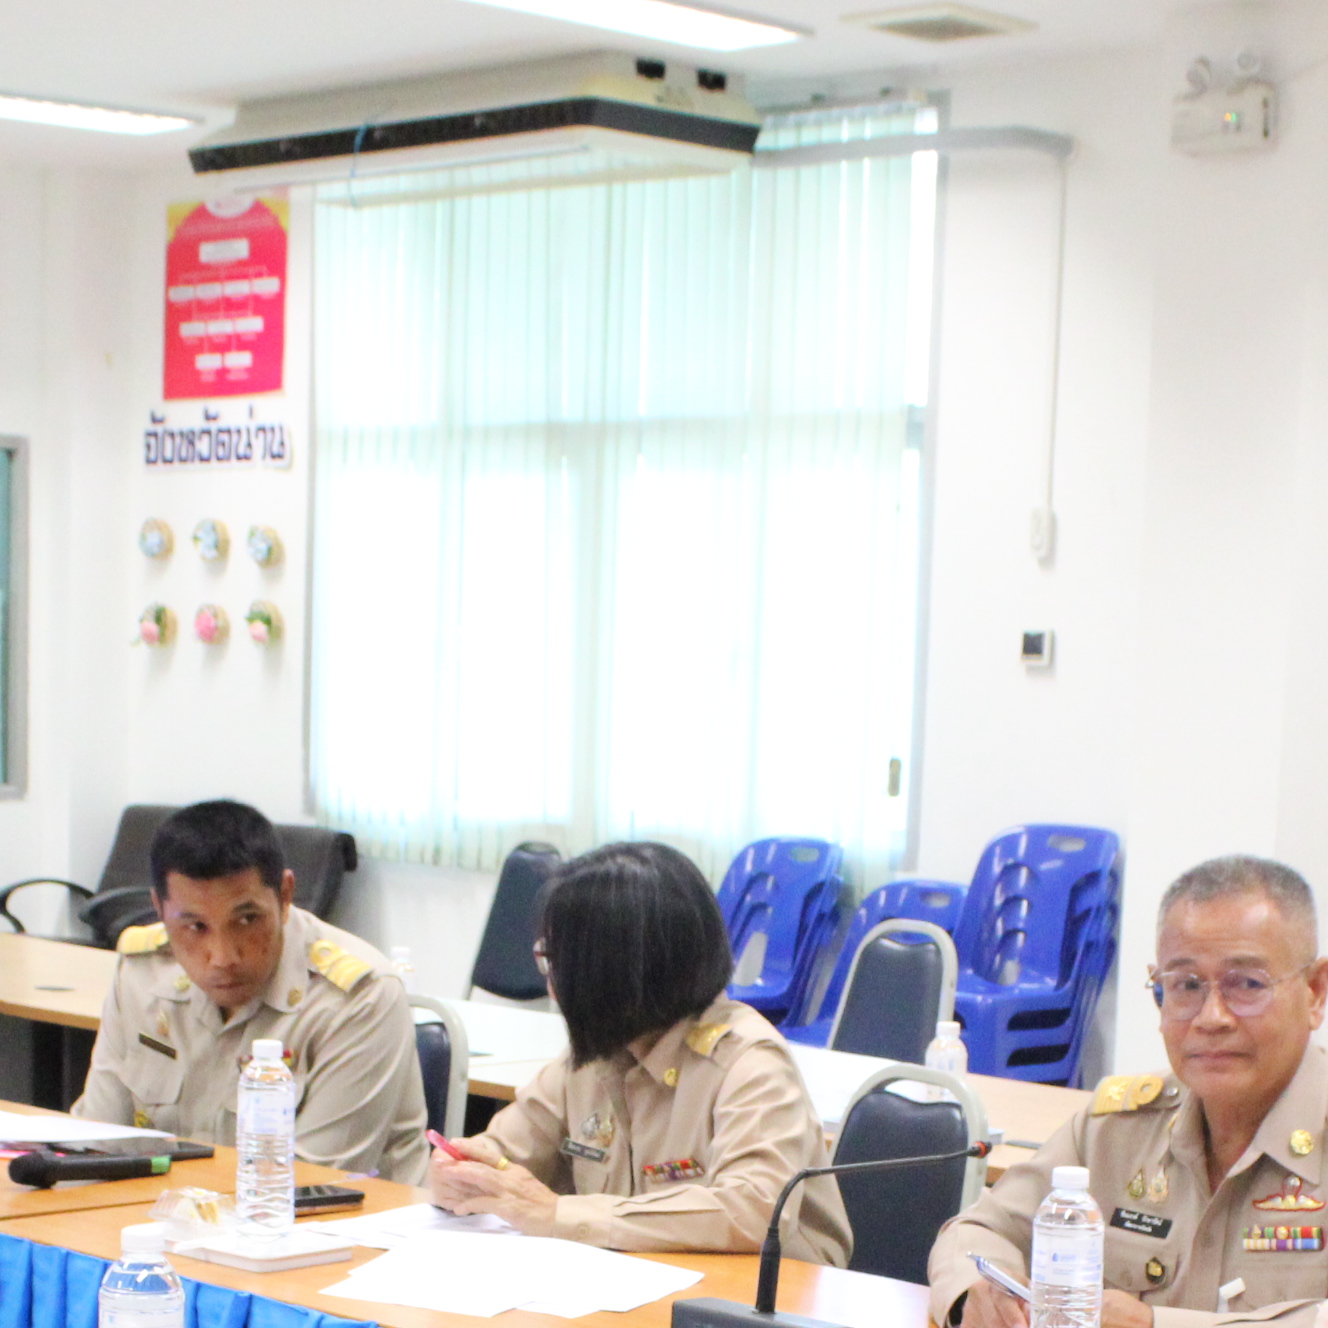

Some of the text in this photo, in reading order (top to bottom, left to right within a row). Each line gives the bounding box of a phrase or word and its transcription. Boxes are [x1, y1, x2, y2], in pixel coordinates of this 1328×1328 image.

[145, 404, 285, 464] จังหวัดน่าน
